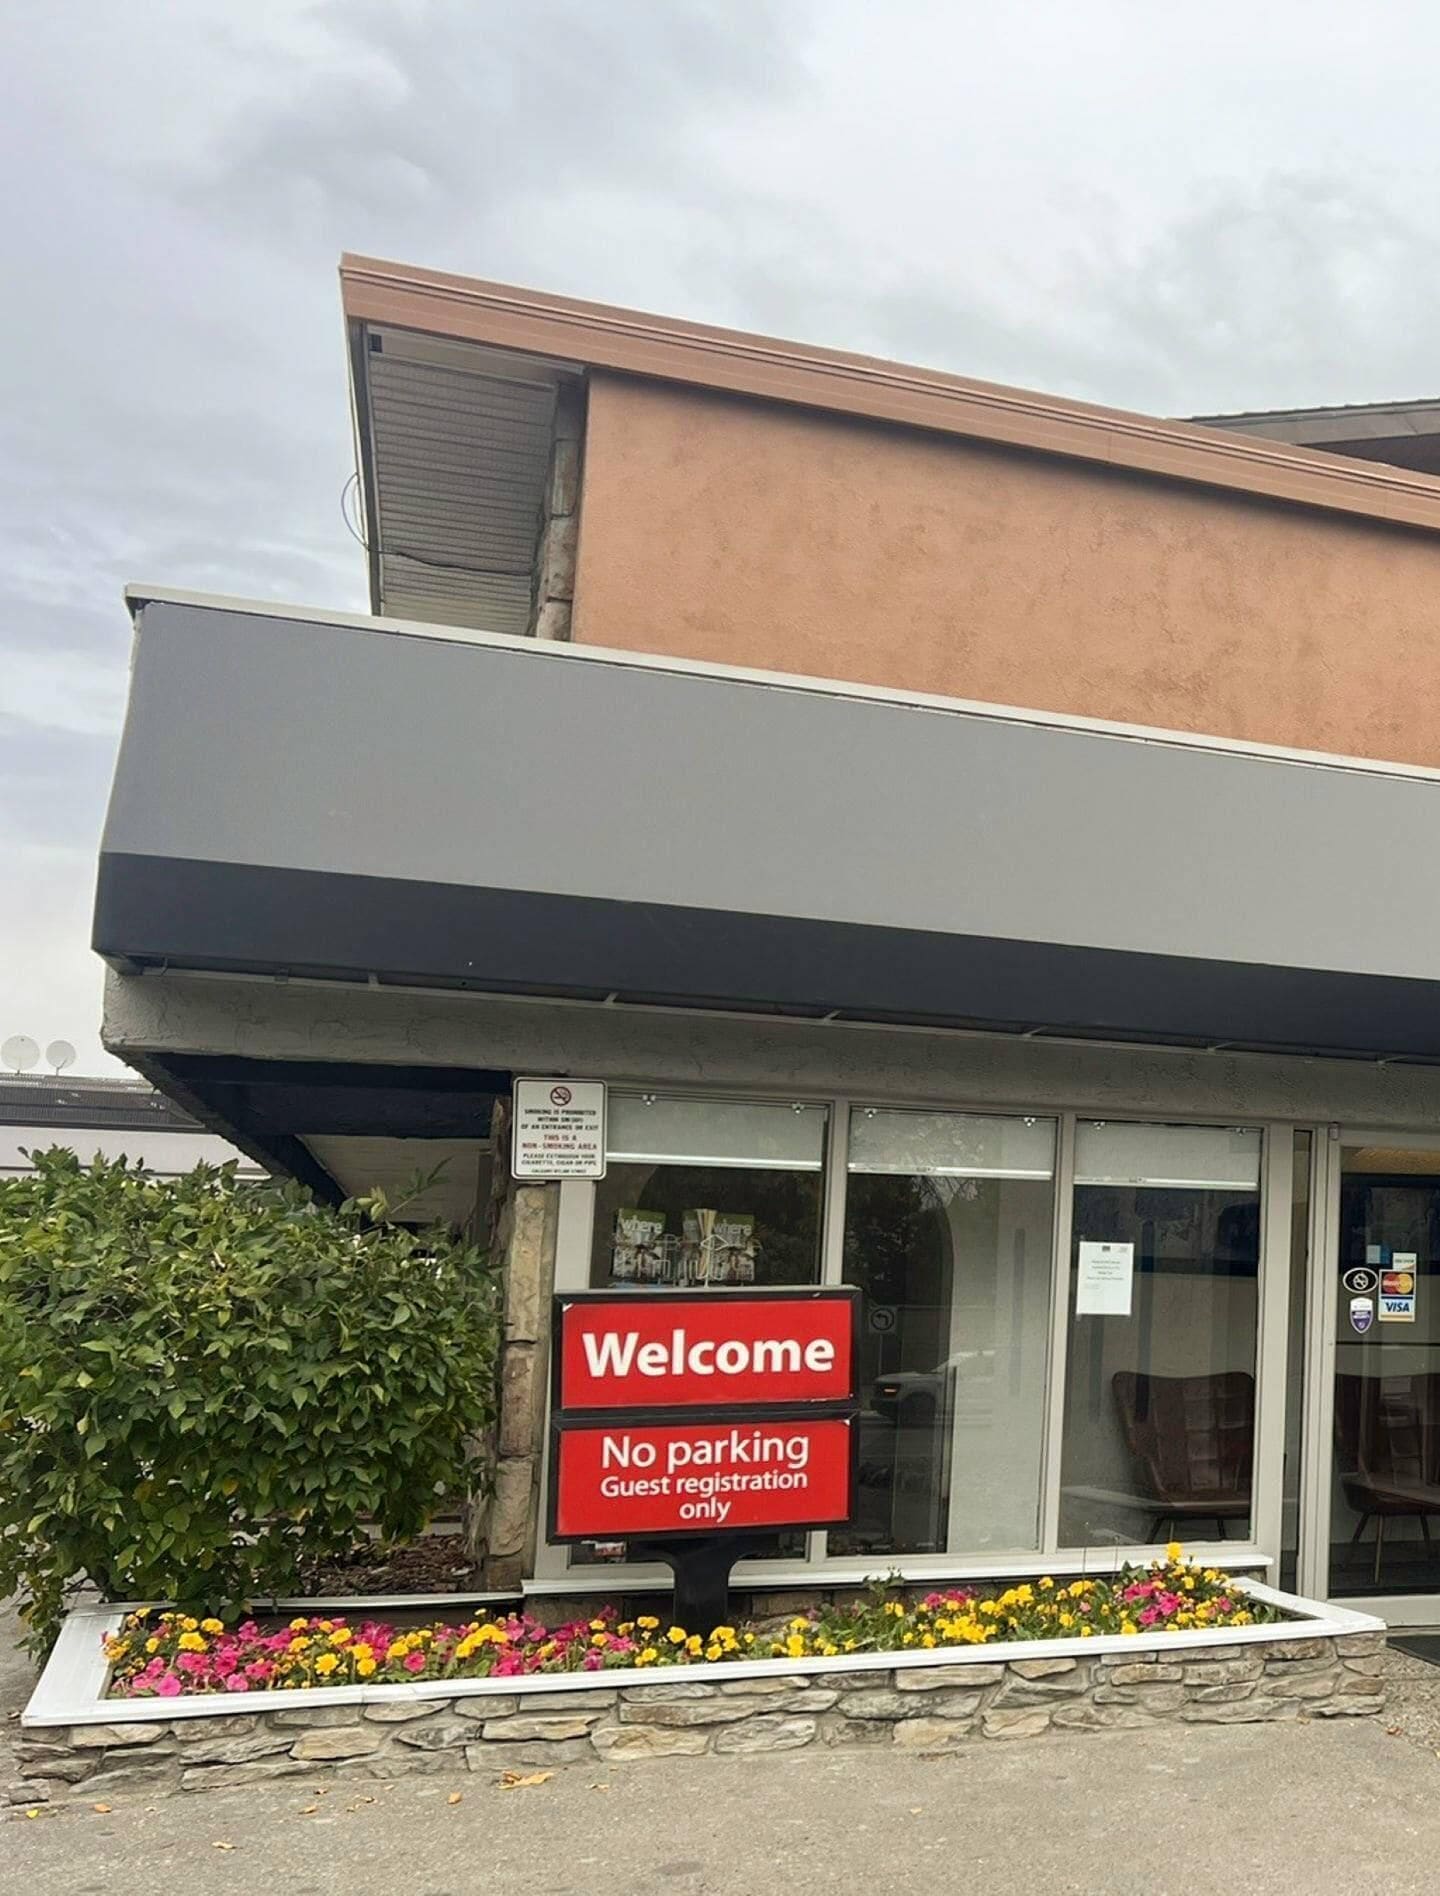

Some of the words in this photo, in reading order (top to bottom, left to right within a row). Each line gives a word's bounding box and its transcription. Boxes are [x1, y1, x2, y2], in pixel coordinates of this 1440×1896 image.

[622, 1214, 662, 1234] where
[1385, 1302, 1410, 1313] VISA
[581, 1328, 835, 1378] Welcome
[601, 1435, 657, 1470] No
[667, 1430, 810, 1475] parking
[600, 1475, 670, 1498] Guest
[675, 1469, 808, 1500] registration
[678, 1496, 732, 1523] only
